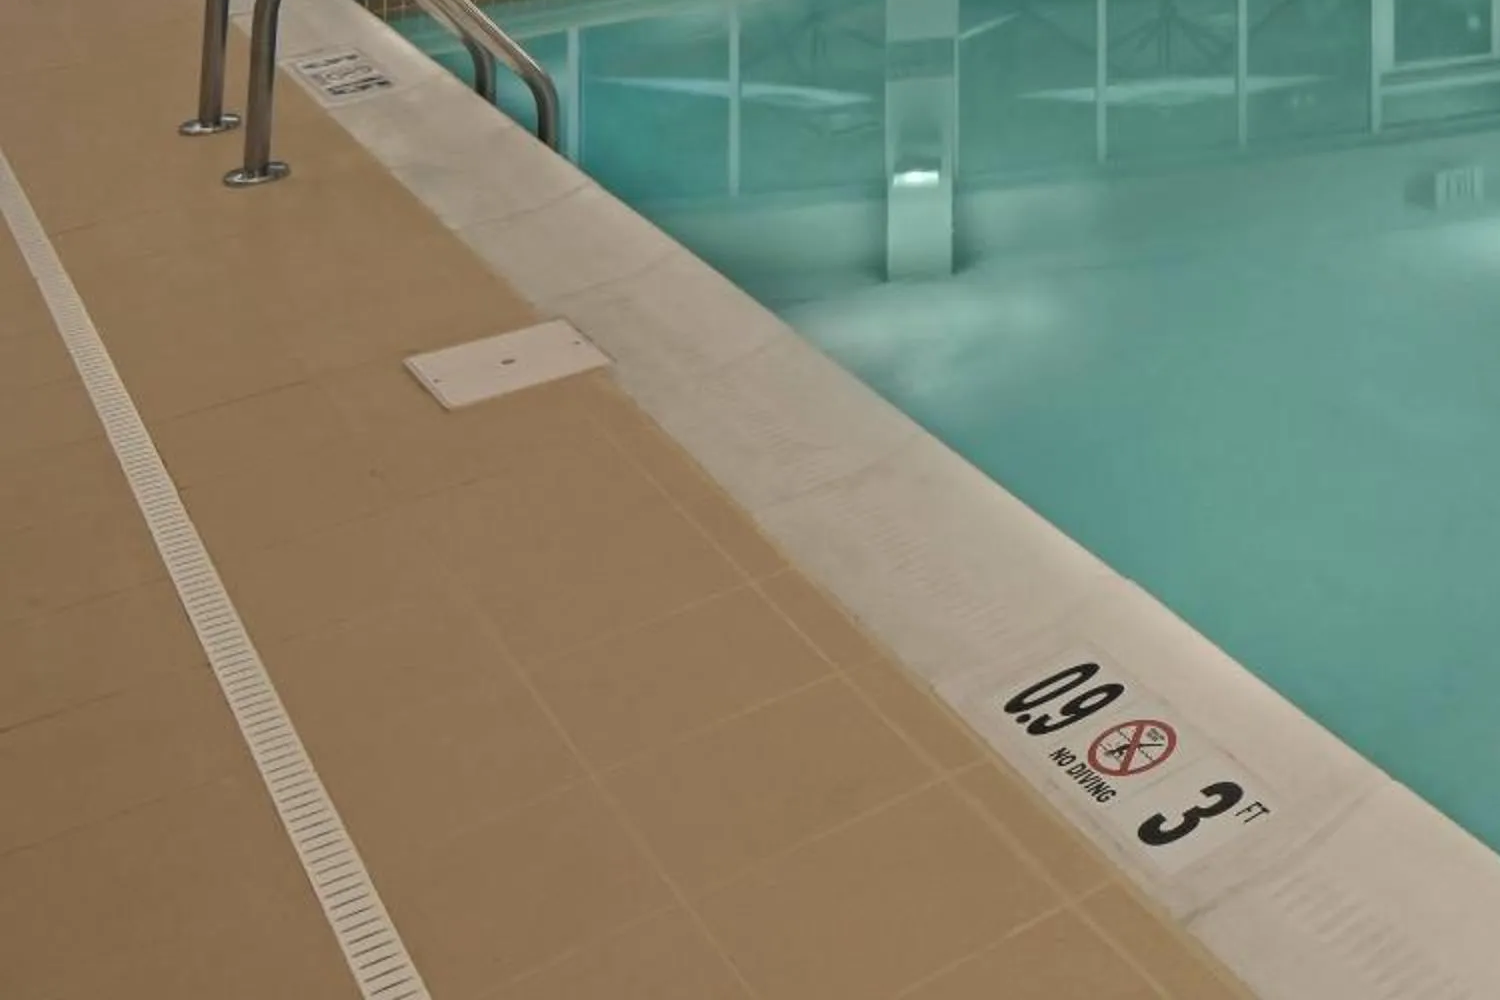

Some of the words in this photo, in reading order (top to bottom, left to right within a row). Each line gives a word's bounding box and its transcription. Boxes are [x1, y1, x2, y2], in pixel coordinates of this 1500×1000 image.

[1049, 746, 1077, 767] NO
[1065, 762, 1117, 803] DIVING
[1137, 781, 1244, 846] 3
[1235, 801, 1270, 824] FT
